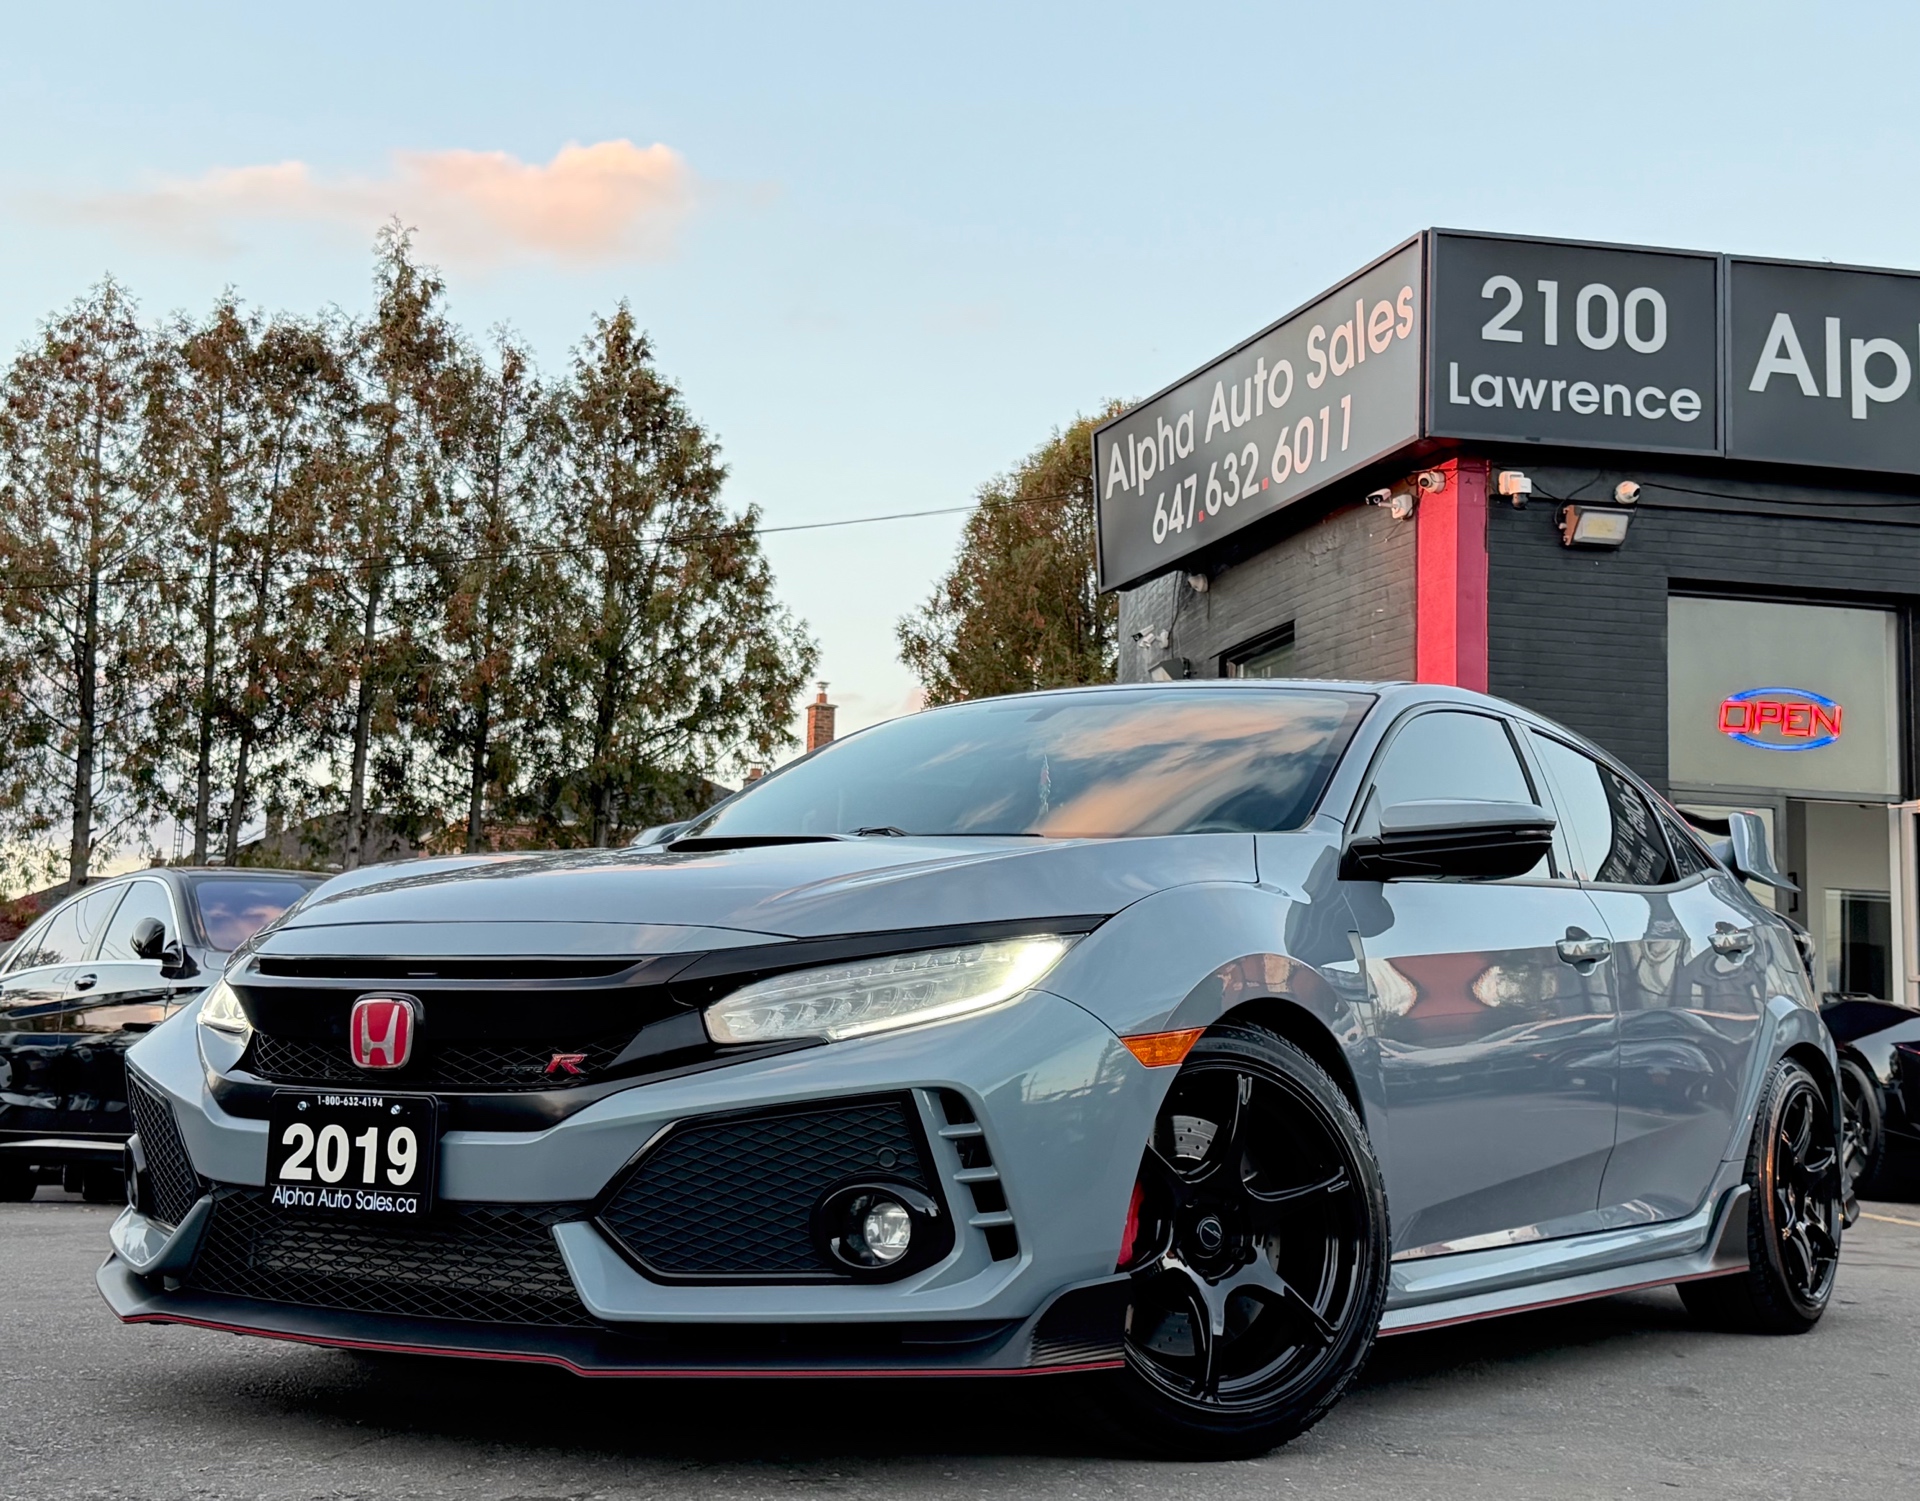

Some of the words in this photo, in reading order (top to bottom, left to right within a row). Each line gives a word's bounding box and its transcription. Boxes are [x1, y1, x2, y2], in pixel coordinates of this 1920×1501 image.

[1481, 275, 1667, 353] 2100
[1105, 409, 1195, 499] Alpha
[1204, 357, 1294, 443] Auto
[1306, 285, 1414, 390] Sales
[1449, 362, 1702, 422] Lawrence
[1748, 312, 1920, 420] Alp
[1152, 394, 1352, 544] 647.632.6011
[1718, 700, 1842, 738] OPEN
[544, 1053, 588, 1075] R
[317, 1095, 383, 1108] 1-800-632-4194
[279, 1122, 418, 1186] 2019
[271, 1185, 315, 1209] Alpha
[317, 1188, 352, 1209] Auto
[355, 1190, 417, 1214] Sales.ca
